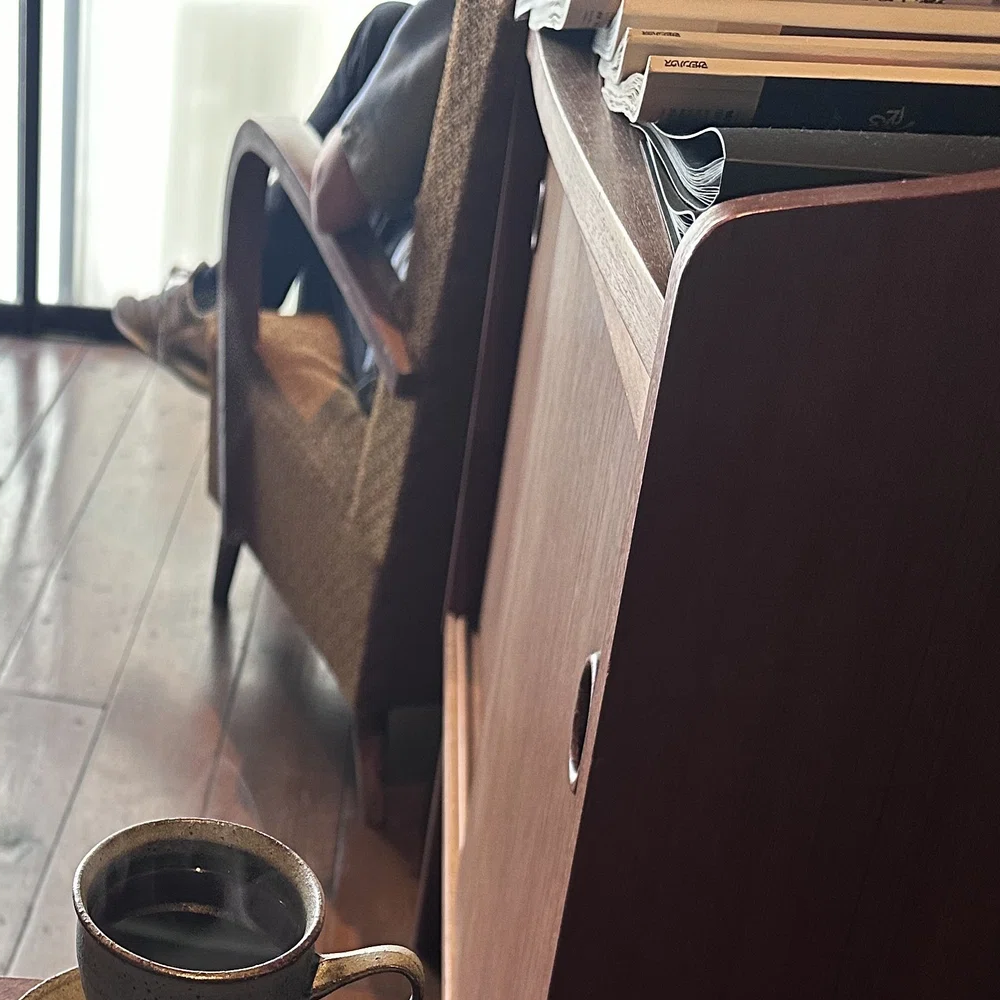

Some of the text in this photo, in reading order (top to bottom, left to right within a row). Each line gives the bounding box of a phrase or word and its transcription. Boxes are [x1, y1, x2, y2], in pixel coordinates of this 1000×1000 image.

[664, 59, 709, 69] マガジンハウス
